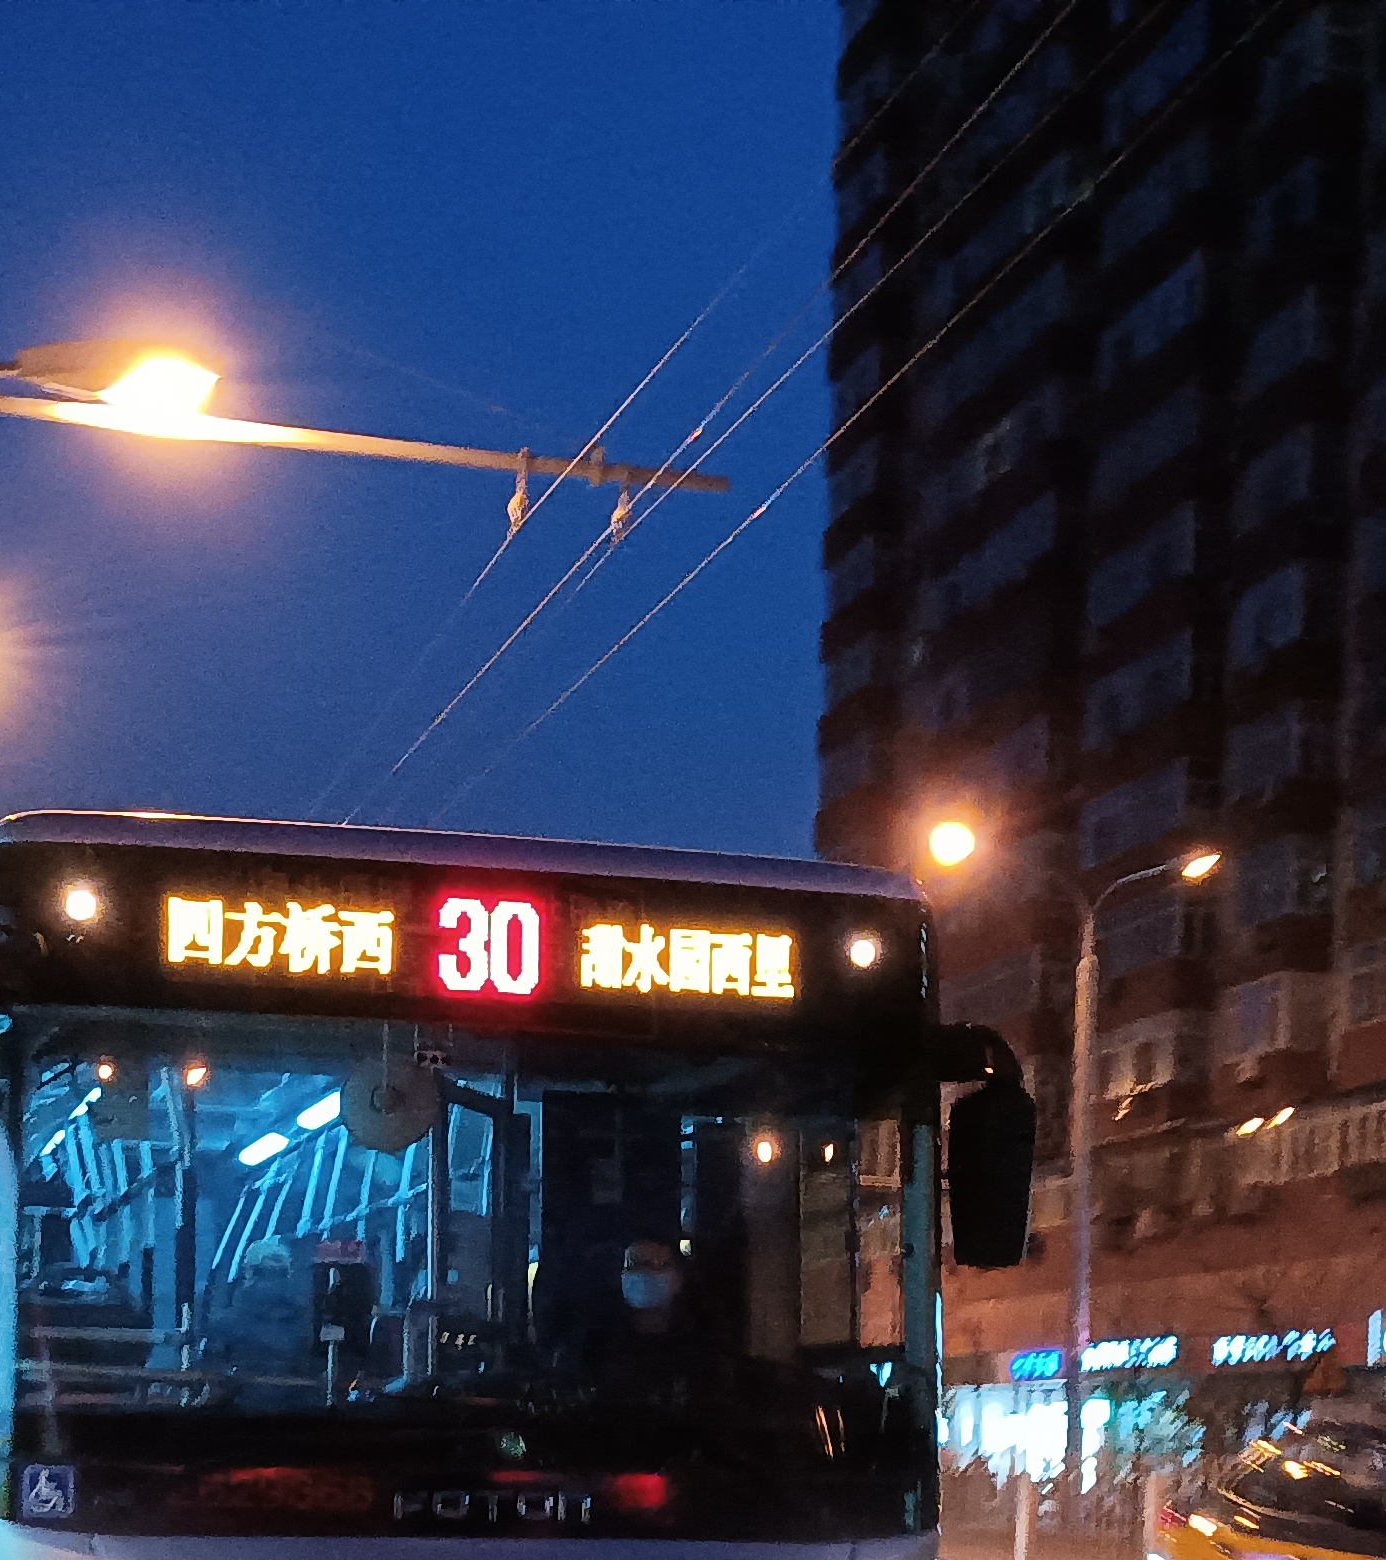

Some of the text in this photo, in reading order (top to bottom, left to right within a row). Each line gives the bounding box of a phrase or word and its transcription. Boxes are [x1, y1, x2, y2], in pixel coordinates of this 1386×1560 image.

[167, 896, 395, 975] 四方桥西
[438, 897, 541, 995] 30
